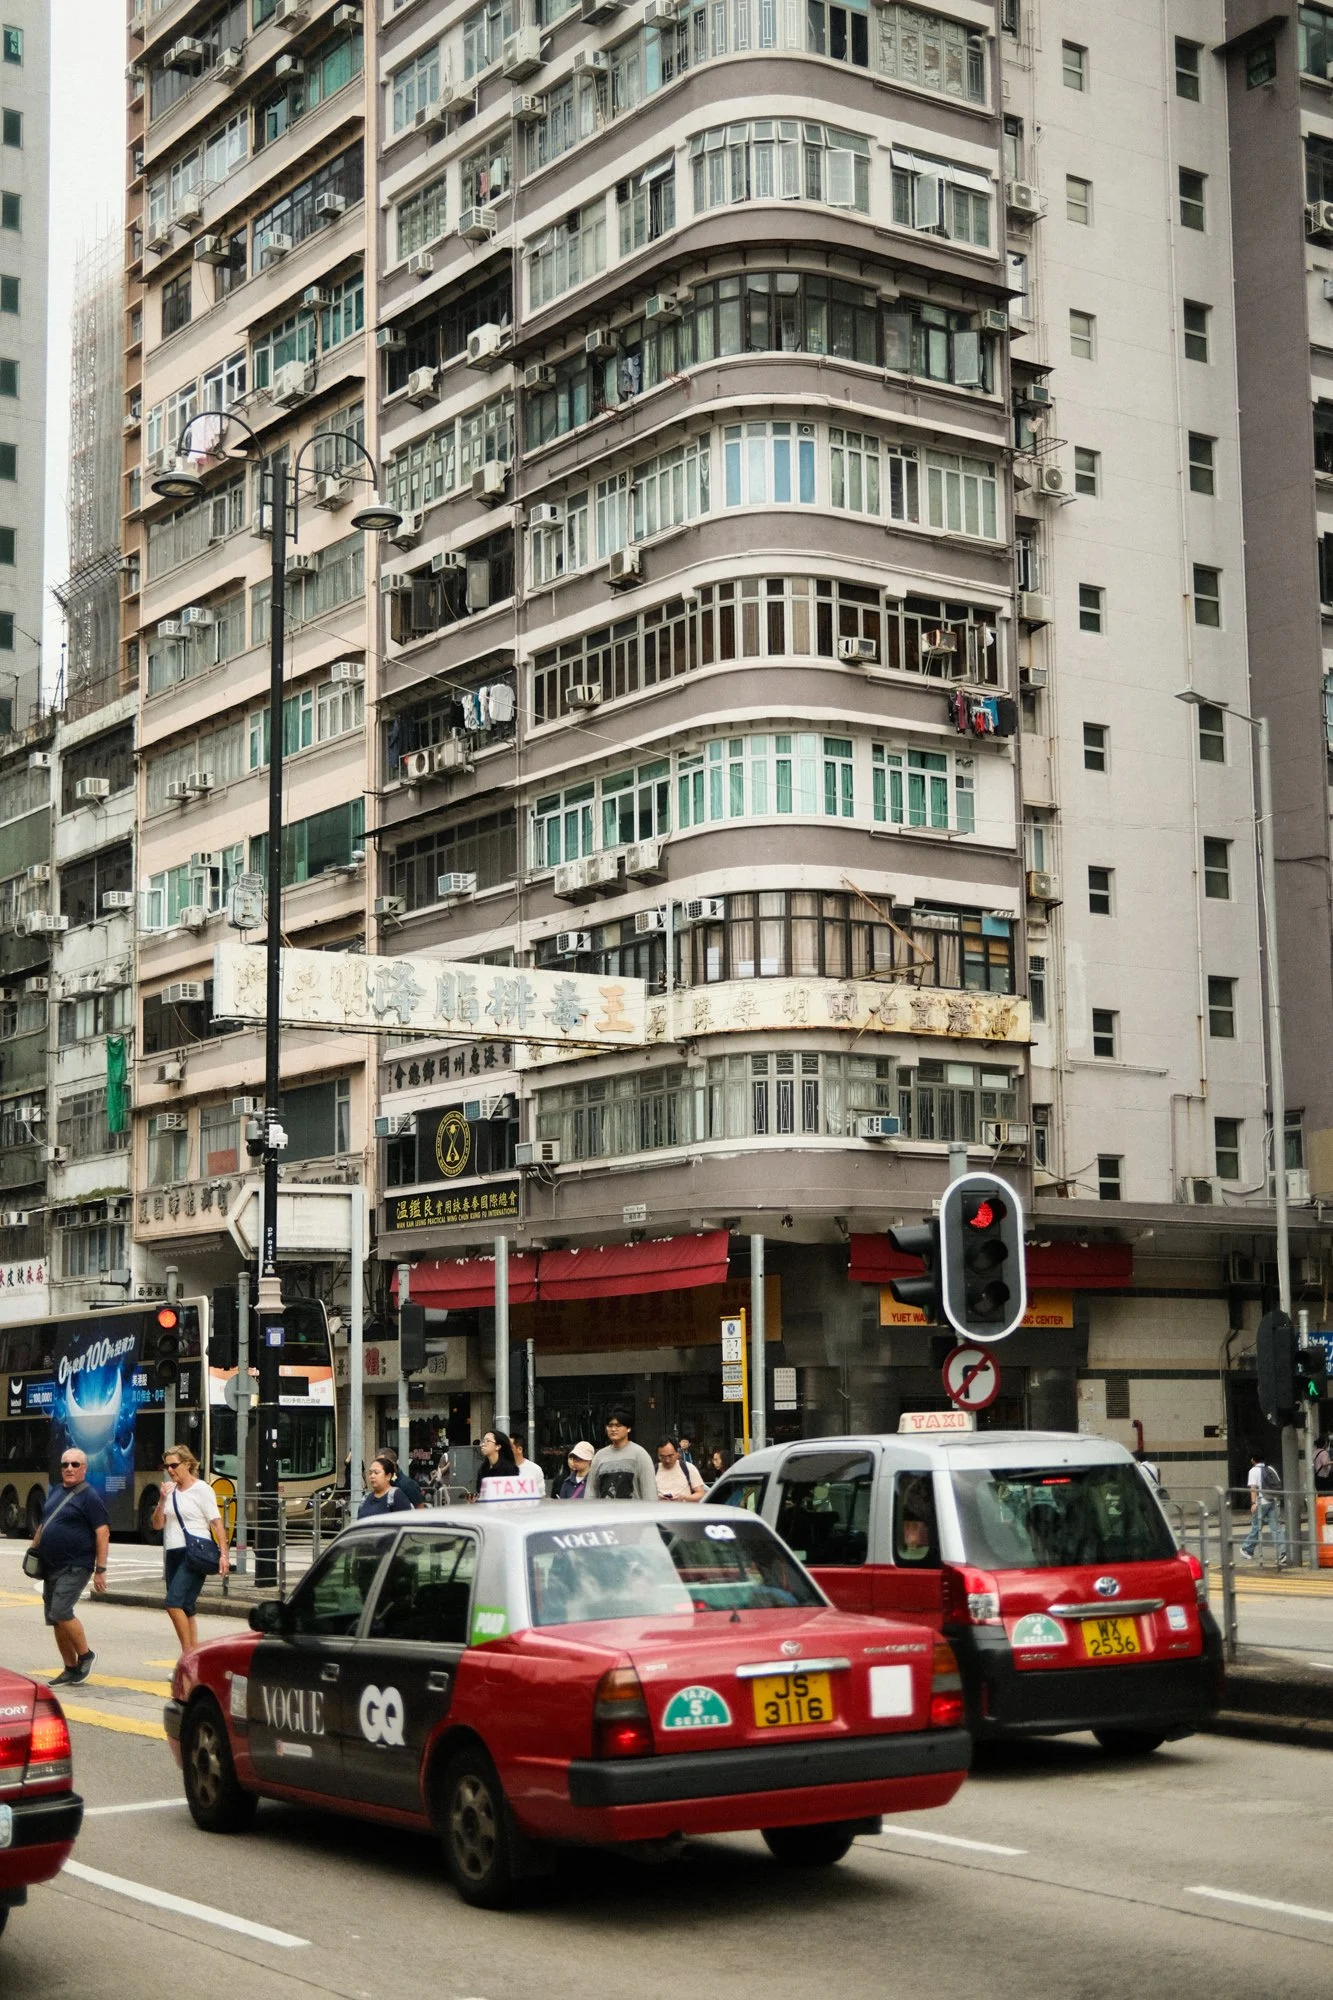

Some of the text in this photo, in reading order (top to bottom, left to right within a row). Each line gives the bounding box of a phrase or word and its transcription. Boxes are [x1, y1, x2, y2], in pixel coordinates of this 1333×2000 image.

[415, 1219, 427, 1227] LEUNG
[428, 1216, 446, 1225] PRACTICAL
[447, 1214, 458, 1222] WING
[459, 1213, 469, 1221] CHUN
[470, 1211, 481, 1219] KUNG
[482, 1209, 487, 1218] FU
[488, 1207, 518, 1217] INTERNATIONAL
[891, 1312, 927, 1322] YUET WA
[1035, 1315, 1063, 1325] CENTER
[911, 1413, 965, 1429] TAXI
[493, 1479, 536, 1495] TAXI
[552, 1530, 619, 1549] VOGUE
[1032, 1623, 1044, 1636] 4
[1096, 1619, 1121, 1638] WX
[1090, 1636, 1136, 1656] 2536
[681, 1688, 712, 1702] TAXI
[774, 1674, 810, 1699] JS
[261, 1685, 325, 1735] VOGUE
[359, 1685, 406, 1746] GQ
[689, 1699, 704, 1716] 5
[764, 1697, 824, 1725] 3116
[674, 1715, 719, 1726] SEATS
